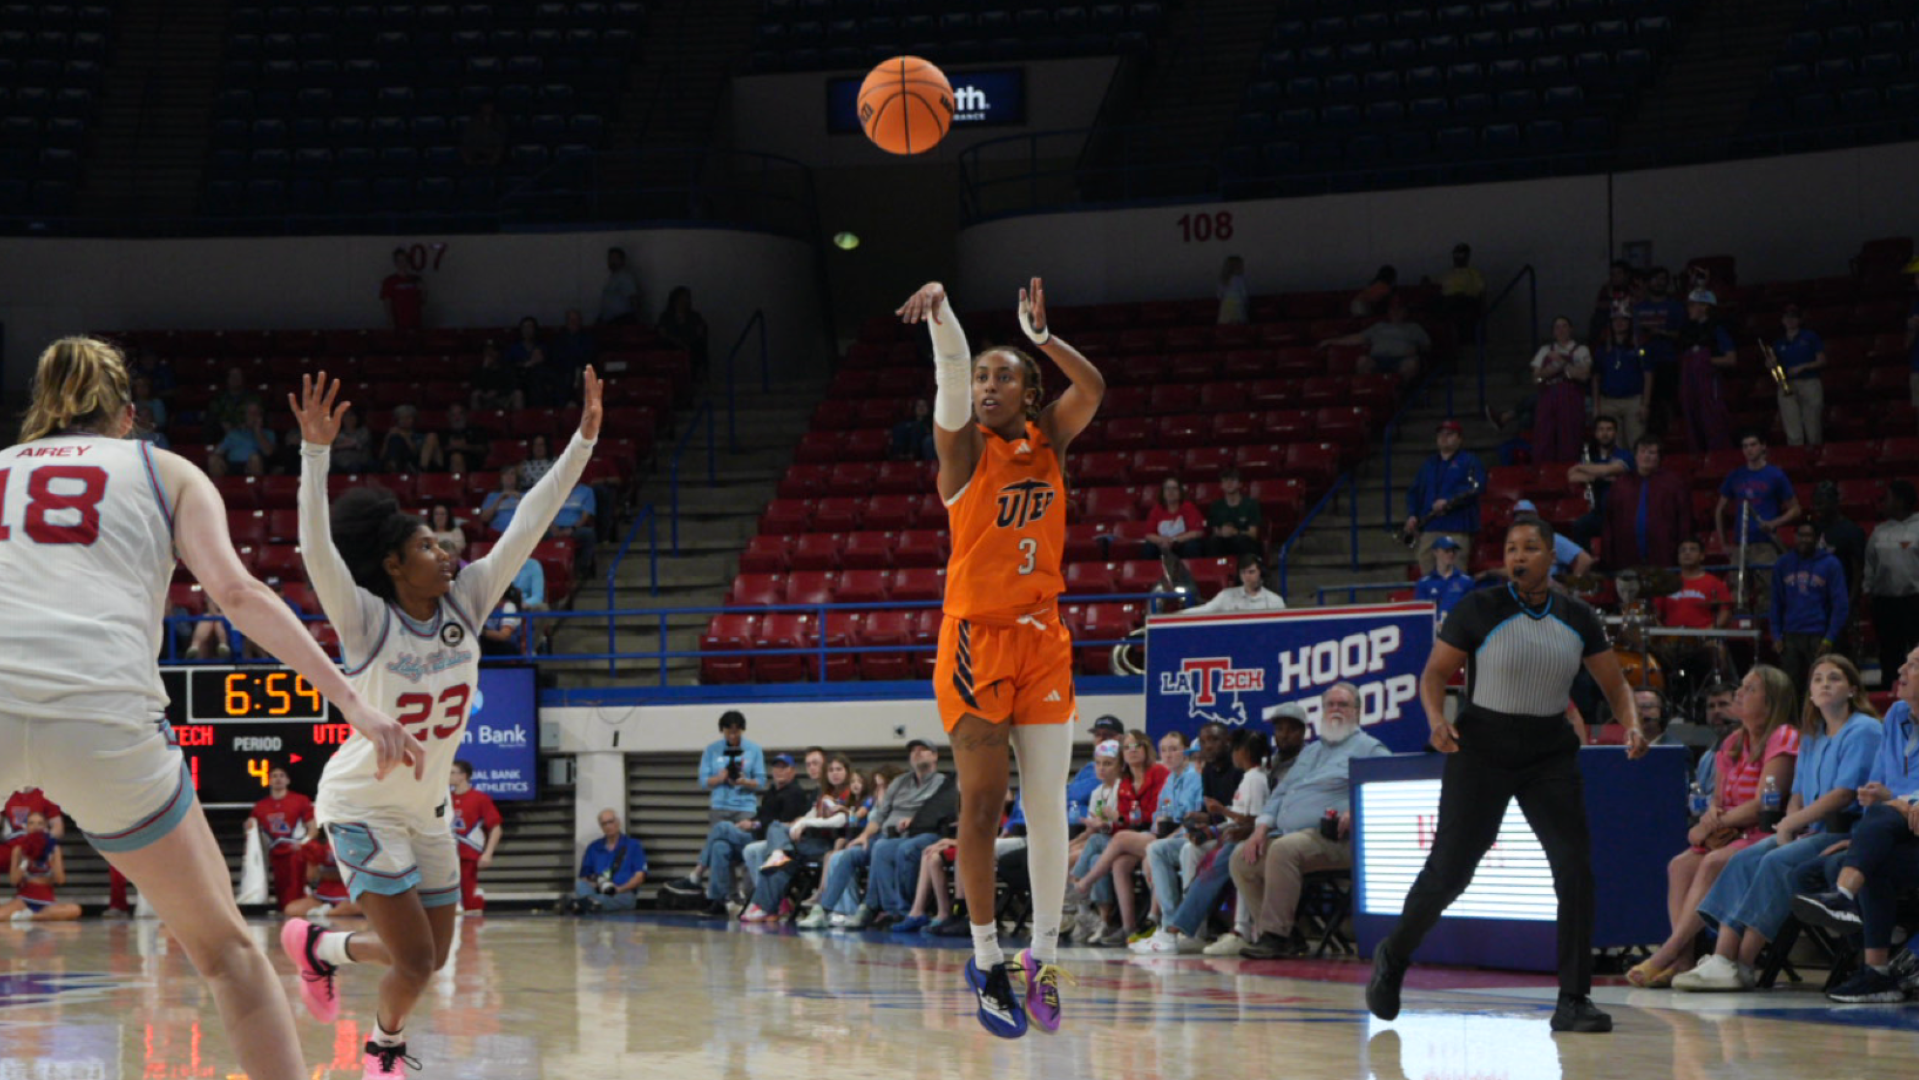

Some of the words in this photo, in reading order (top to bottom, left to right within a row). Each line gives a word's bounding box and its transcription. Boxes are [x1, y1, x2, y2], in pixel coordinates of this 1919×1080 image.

[1177, 211, 1234, 242] 108
[409, 242, 448, 271] 07
[16, 444, 93, 458] AIREY
[0, 465, 109, 546] 18
[1017, 537, 1037, 576] 3
[1277, 624, 1402, 694] HOOP
[224, 673, 321, 715] 6:54
[396, 683, 471, 742] 23
[1261, 673, 1418, 746] ROP
[232, 736, 283, 751] PERIOD
[478, 723, 527, 744] Bank
[247, 758, 270, 787] 4
[475, 781, 529, 793] ATHLETICS
[491, 769, 521, 780] BANK
